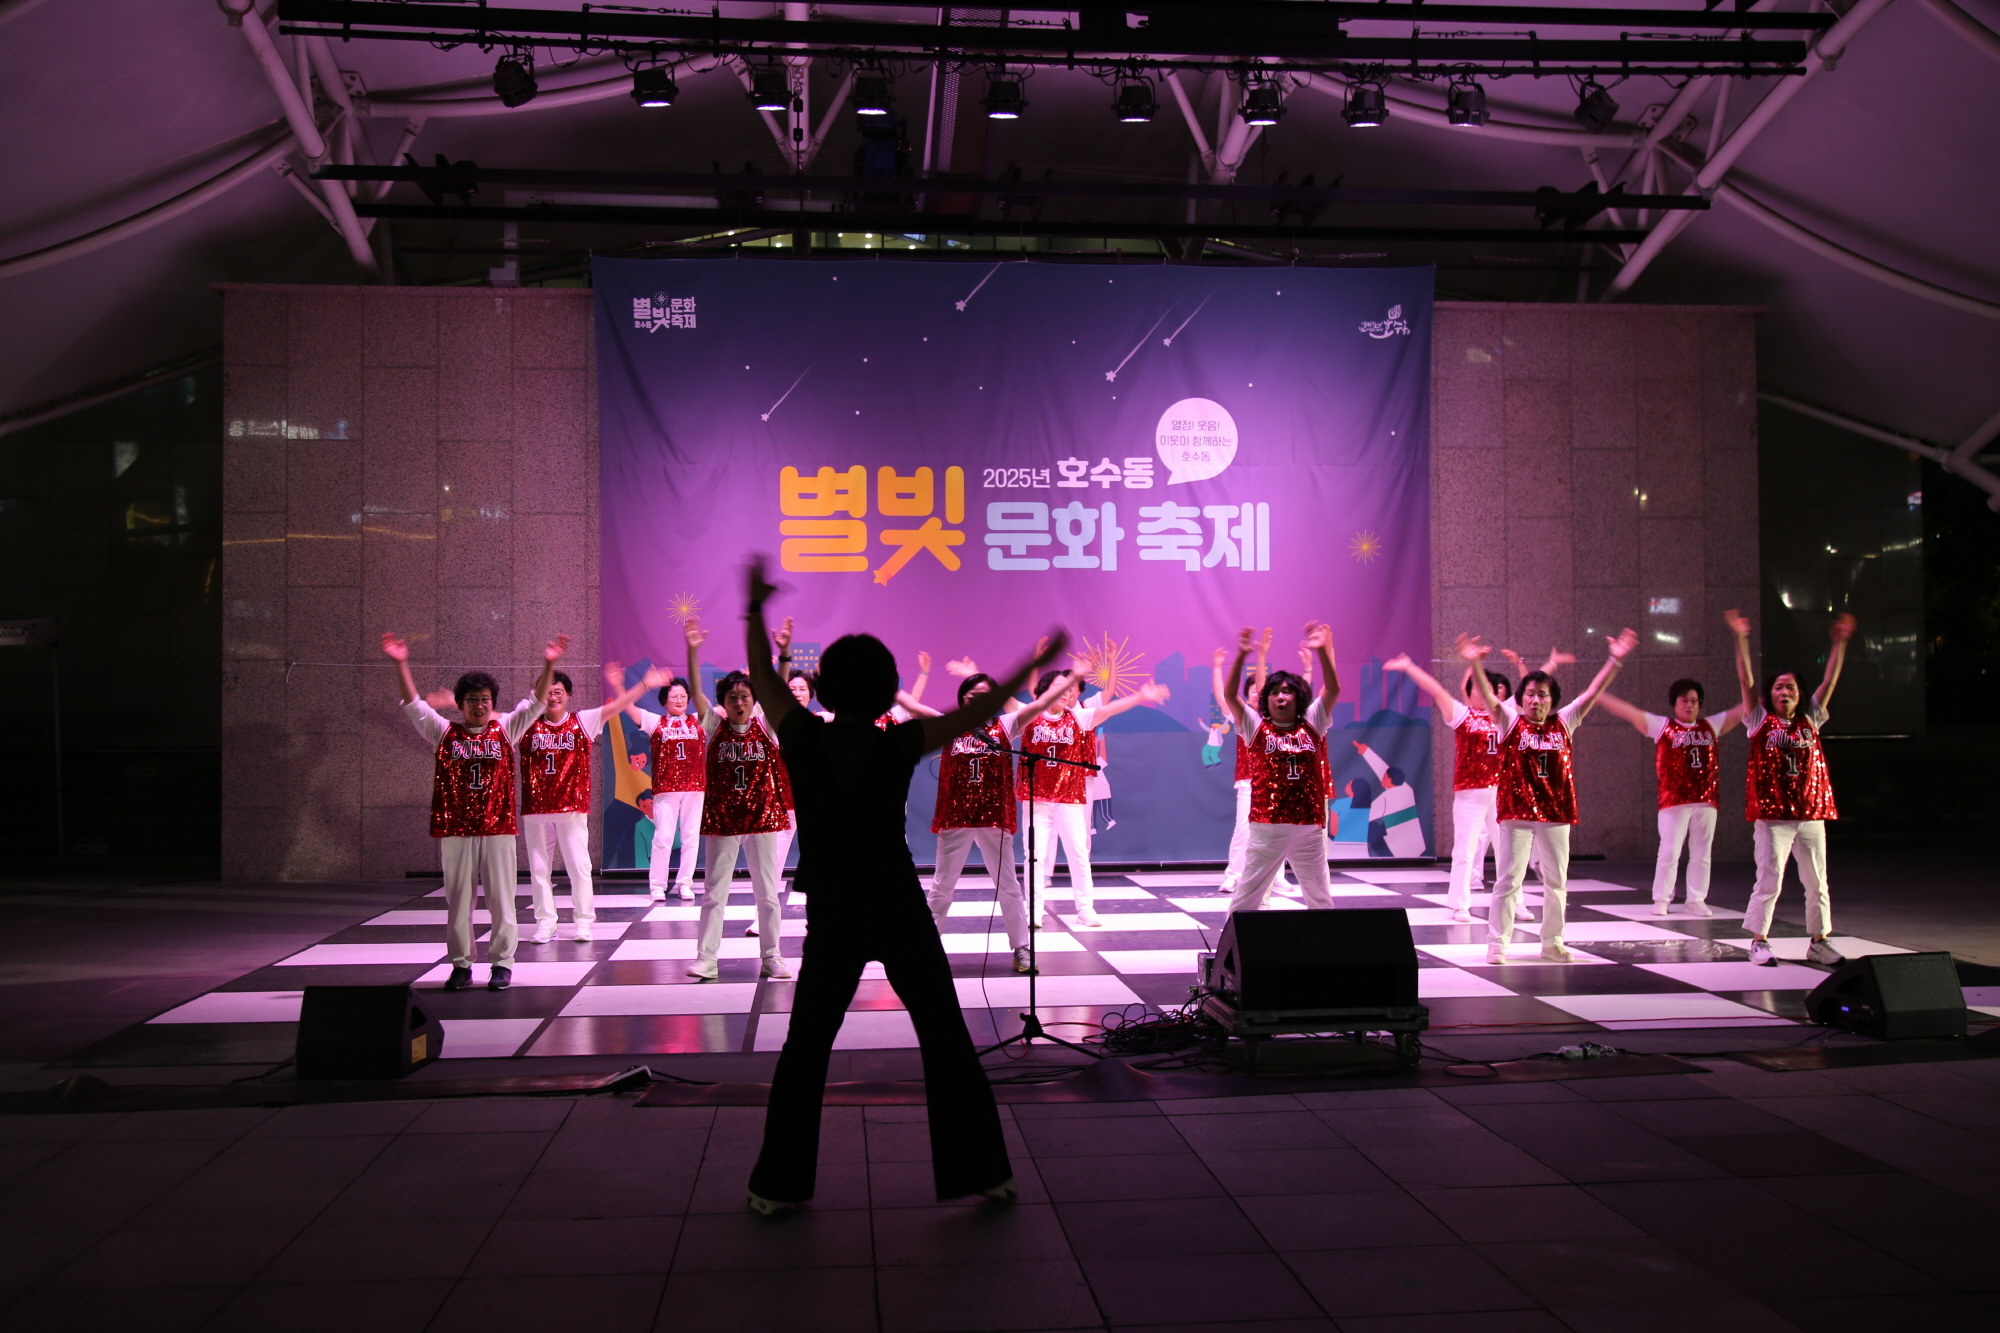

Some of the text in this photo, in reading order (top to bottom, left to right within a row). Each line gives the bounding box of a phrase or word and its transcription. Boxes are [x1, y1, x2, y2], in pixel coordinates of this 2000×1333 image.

[633, 297, 670, 333] 별빛
[670, 296, 696, 313] 문화
[634, 320, 652, 328] 호수동
[671, 314, 697, 329] 축제
[1172, 420, 1220, 431] 열정! 웃음!
[1160, 435, 1232, 446] 이웃이 함께하는
[1181, 451, 1211, 462] 호수동
[983, 456, 1155, 489] 2025년 호수동
[779, 465, 1270, 586] 별빛 문화 축제
[530, 732, 575, 751] BULLS
[1032, 726, 1075, 744] BULLS
[1264, 733, 1316, 754] BULLS
[1487, 732, 1498, 755] 1
[1518, 731, 1565, 751] BULLS
[1672, 731, 1714, 748] BULLS
[1766, 728, 1814, 750] BULLS
[450, 739, 502, 761] BULLS
[676, 742, 686, 760] 1
[718, 740, 766, 762] BULLS
[1046, 745, 1057, 767] 1
[1690, 748, 1702, 768] 1
[544, 752, 556, 774] 1
[969, 758, 982, 783] 1
[1286, 754, 1300, 780] 1
[1537, 753, 1548, 778] 1
[1786, 752, 1800, 776] 1
[470, 763, 483, 790] 1
[734, 766, 747, 790] 1
